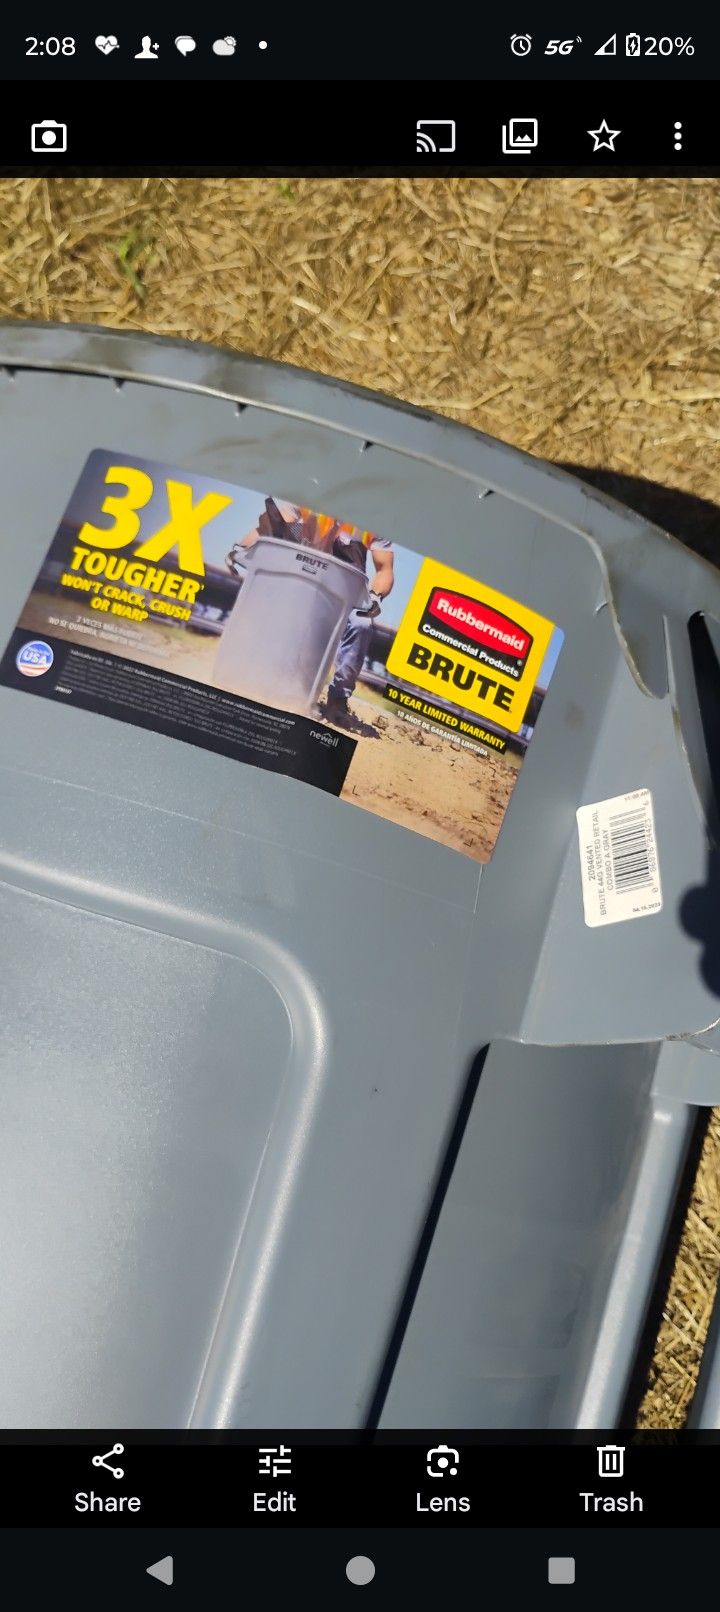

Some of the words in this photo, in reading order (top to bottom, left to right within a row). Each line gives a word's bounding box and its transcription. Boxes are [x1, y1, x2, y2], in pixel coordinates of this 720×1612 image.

[77, 465, 233, 577] 3X
[296, 554, 329, 571] BRUTE
[61, 573, 103, 596] WON'T
[102, 582, 146, 610] CRACK,
[150, 599, 192, 621] CRUSH
[90, 597, 110, 612] OR
[111, 603, 149, 622] WARP
[437, 598, 525, 652] Rubbermaid
[23, 649, 48, 666] USA
[422, 623, 478, 656] Commercial
[479, 651, 519, 678] Products
[407, 643, 515, 713] BRUTE
[388, 688, 397, 699] 10
[399, 693, 422, 711] YEAR
[423, 704, 458, 727] LIMITED
[460, 721, 506, 749] WARRANTY
[421, 720, 431, 730] DE
[309, 729, 339, 748] newell
[592, 808, 600, 837] RETAIL
[594, 838, 603, 868] VENTED
[602, 829, 610, 851] GRAY
[605, 861, 614, 891] COMBO
[599, 888, 607, 916] BRUTE
